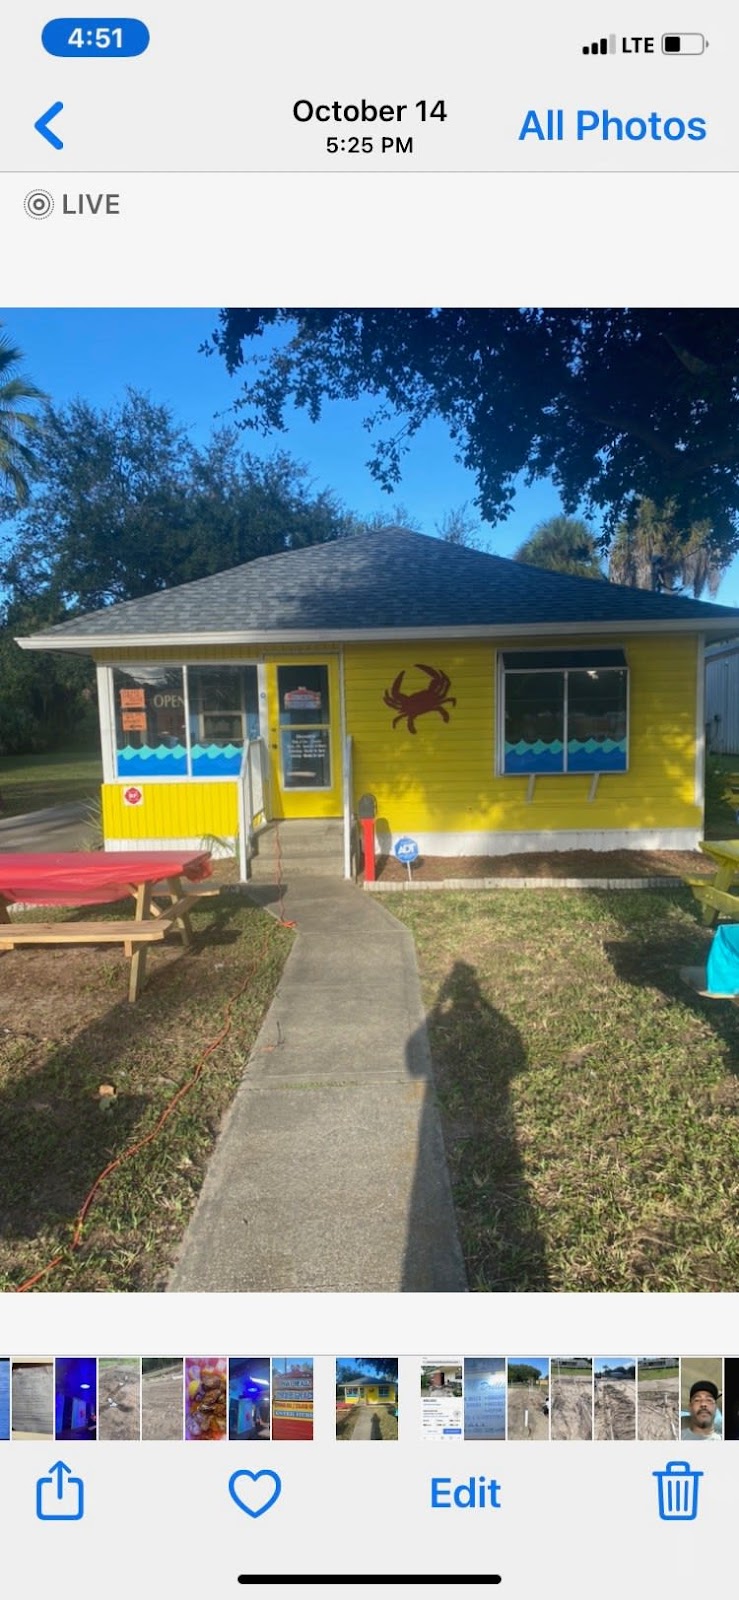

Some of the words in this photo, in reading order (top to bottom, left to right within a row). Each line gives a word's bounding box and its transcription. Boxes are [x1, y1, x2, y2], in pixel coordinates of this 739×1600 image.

[67, 27, 122, 49] 4:51
[622, 37, 655, 54] LTE
[293, 98, 407, 123] October
[415, 100, 448, 123] 14
[518, 109, 563, 141] All
[576, 109, 707, 141] Photos
[326, 136, 374, 154] 5:25
[381, 136, 414, 154] PM
[62, 194, 120, 214] LIVE
[153, 695, 185, 708] OPEN
[397, 842, 416, 854] ADT
[430, 1476, 501, 1508] Edit
